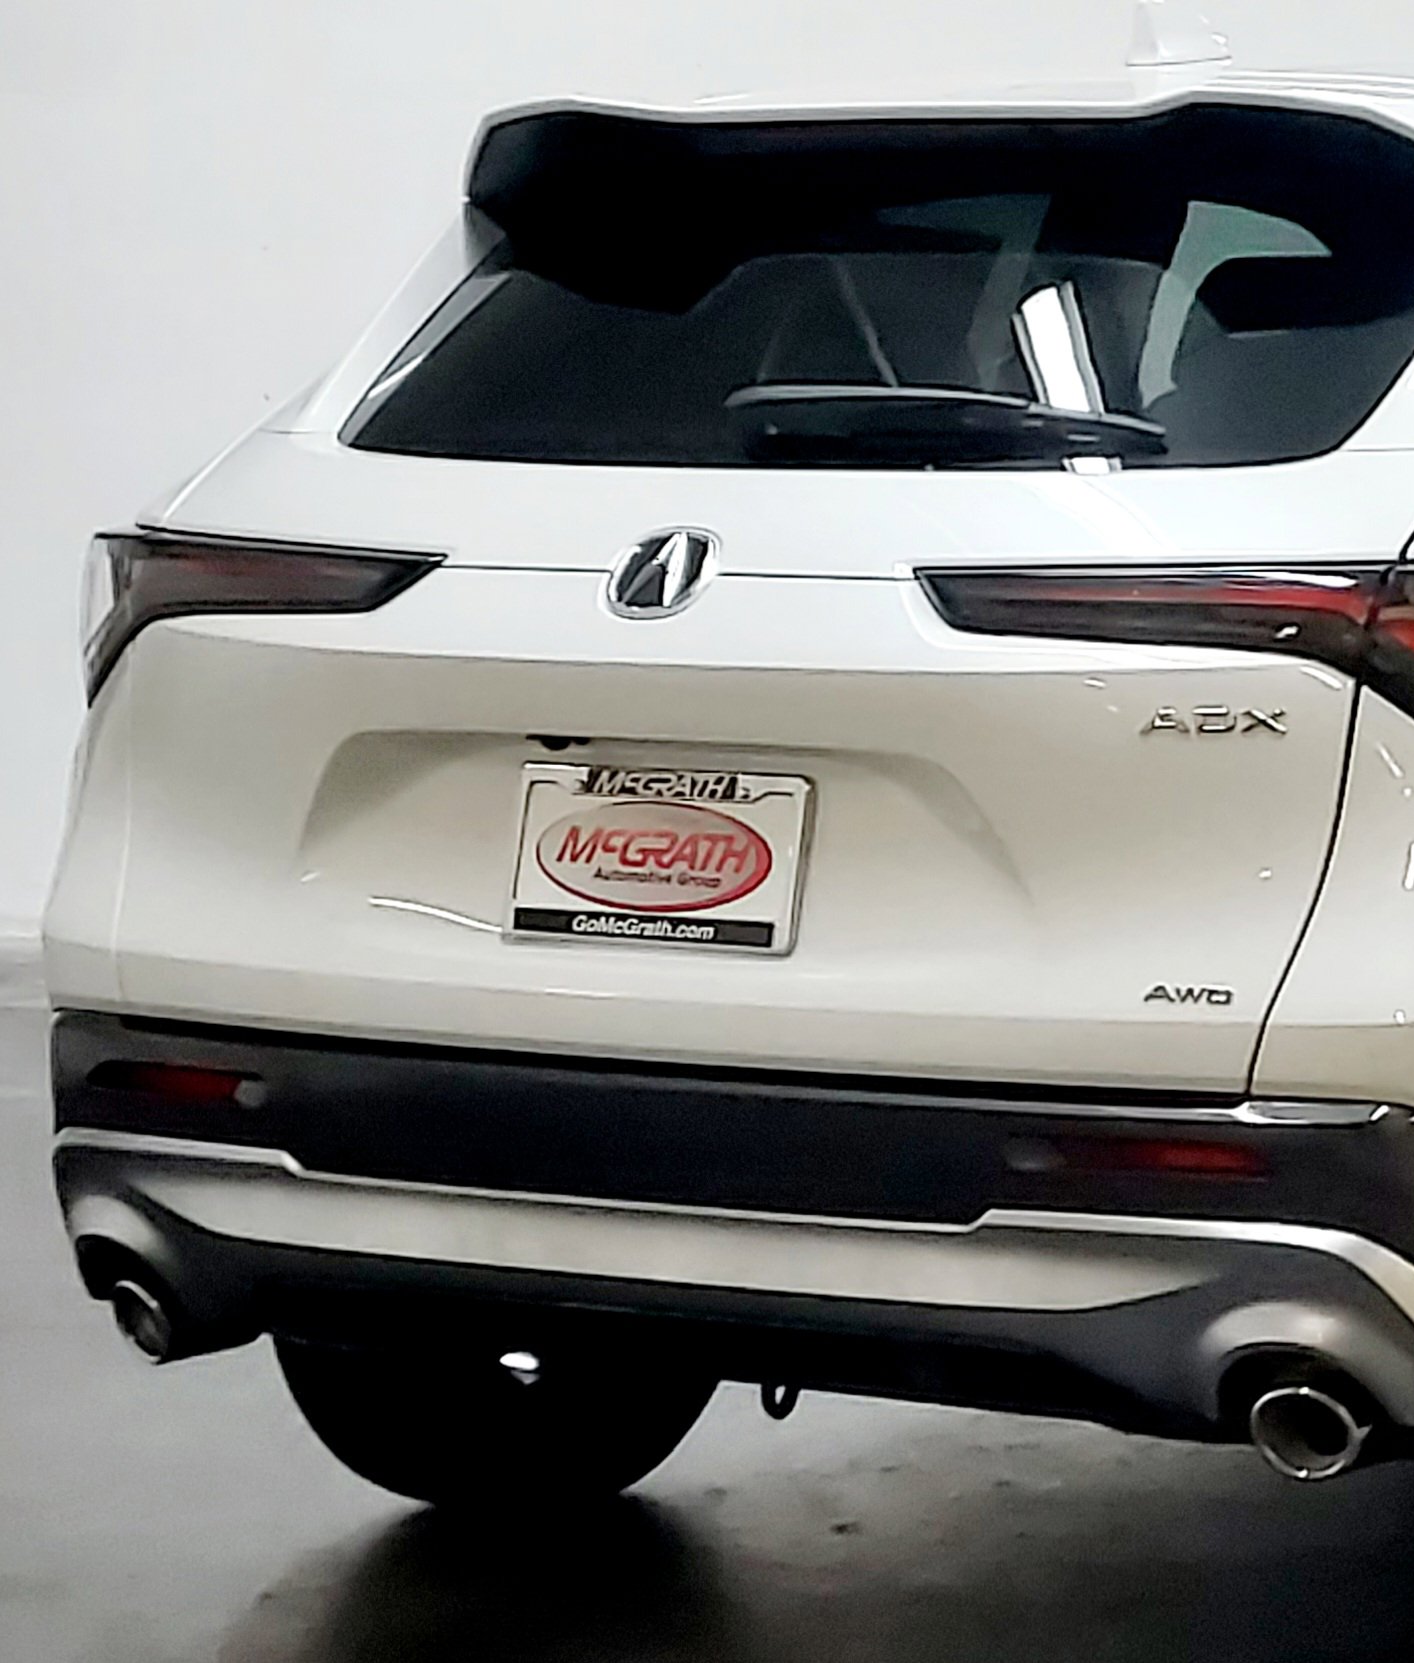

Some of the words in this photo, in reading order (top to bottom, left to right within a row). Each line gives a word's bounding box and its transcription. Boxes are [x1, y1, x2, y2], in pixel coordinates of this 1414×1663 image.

[593, 867, 672, 884] Automotive
[677, 872, 721, 888] Group
[571, 914, 716, 940] GoMcGrath.com
